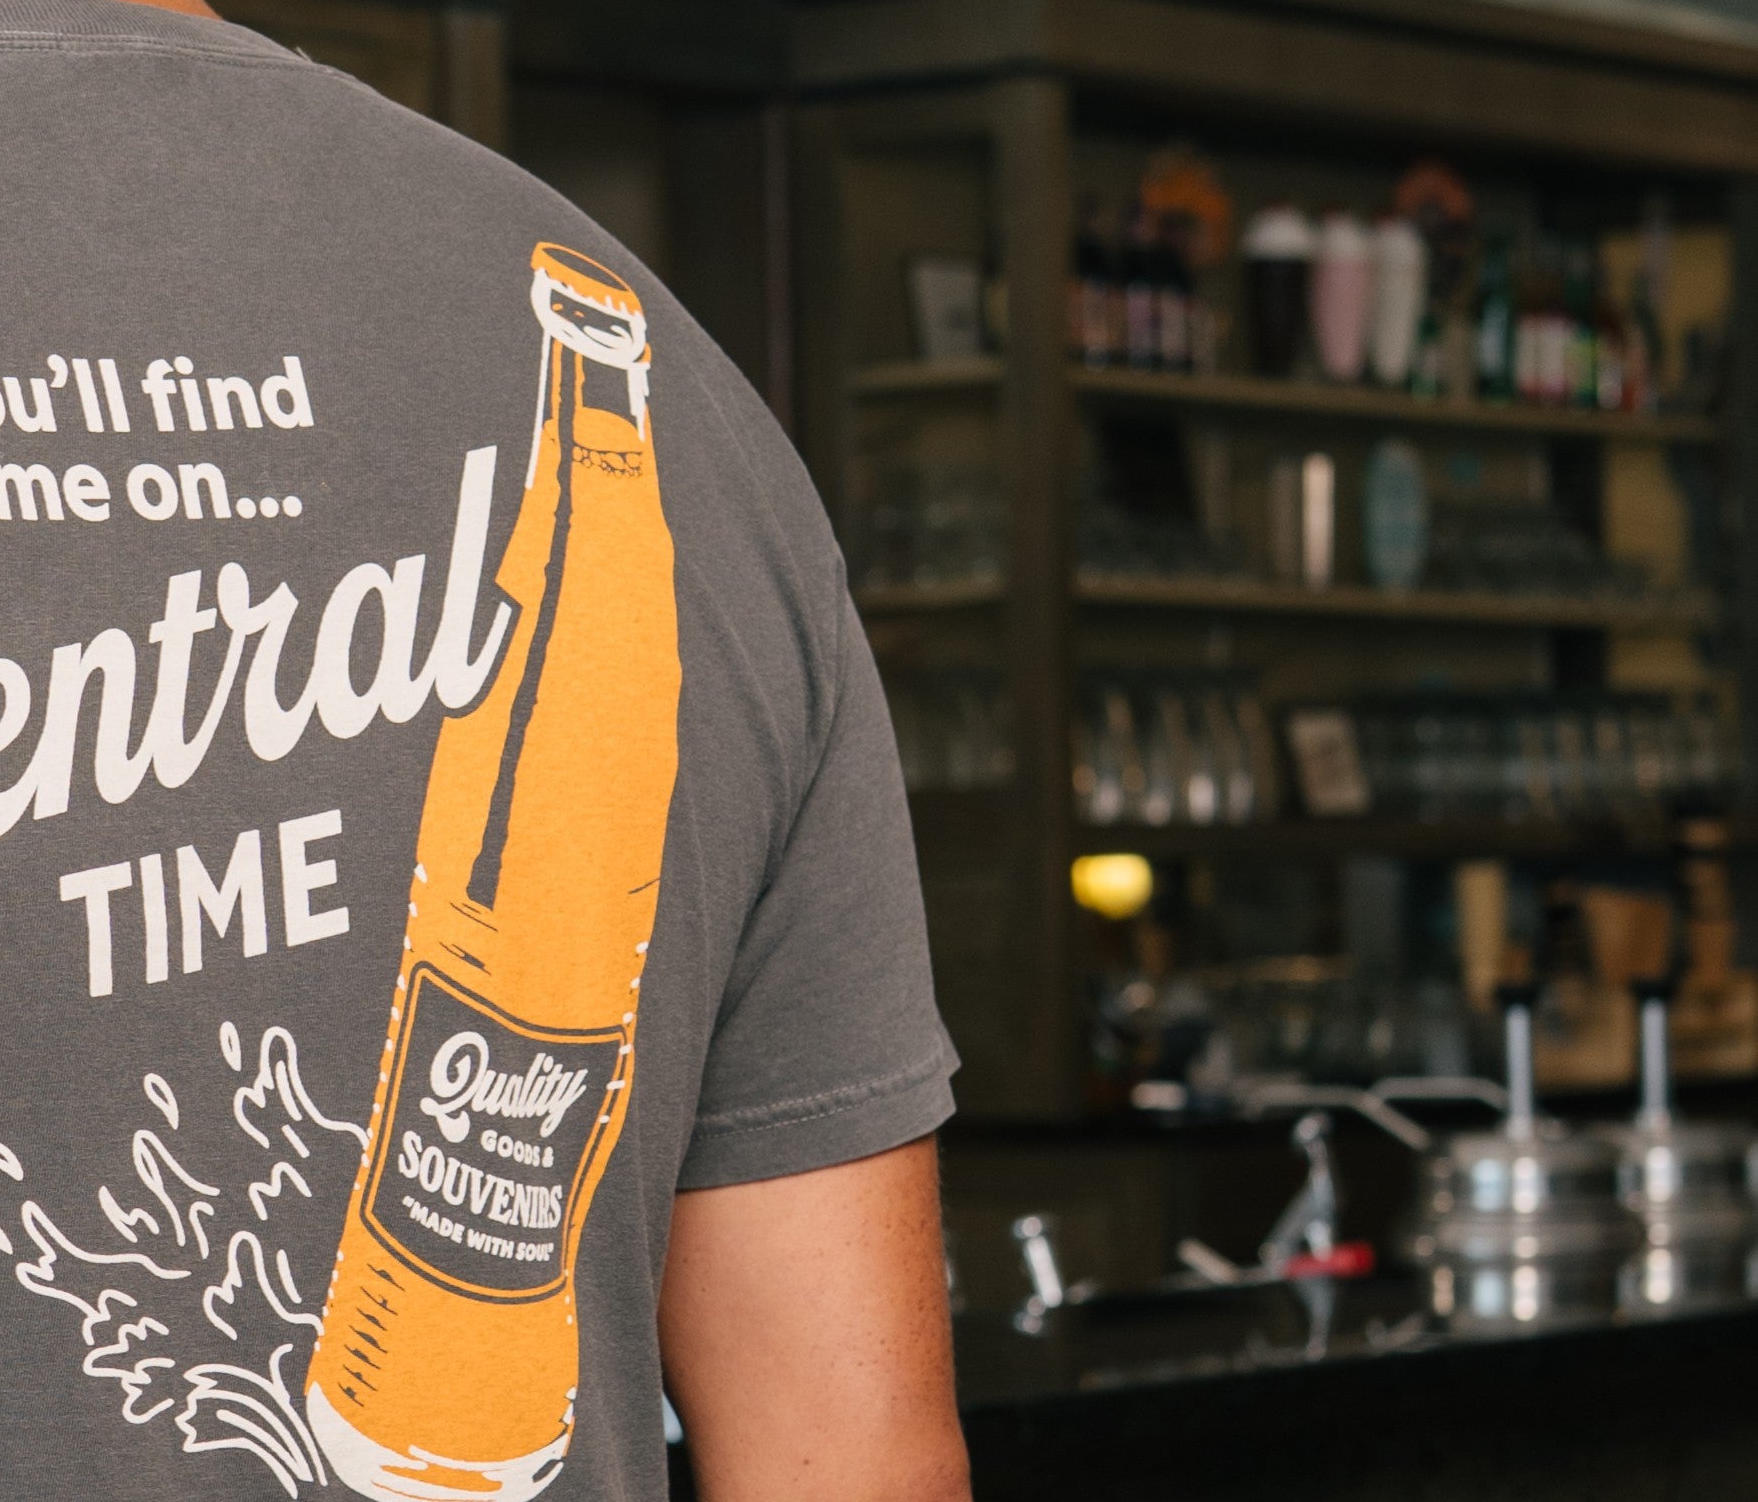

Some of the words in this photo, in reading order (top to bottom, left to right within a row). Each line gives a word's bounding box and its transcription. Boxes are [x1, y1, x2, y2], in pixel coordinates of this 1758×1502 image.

[141, 356, 314, 432] find
[126, 462, 303, 521] on...
[59, 809, 350, 997] TIME
[420, 1031, 589, 1143] Quality
[398, 1130, 562, 1229] SOUVENIRS
[481, 1129, 541, 1167] GOODS
[542, 1147, 555, 1169] &
[467, 1228, 513, 1258] WITH
